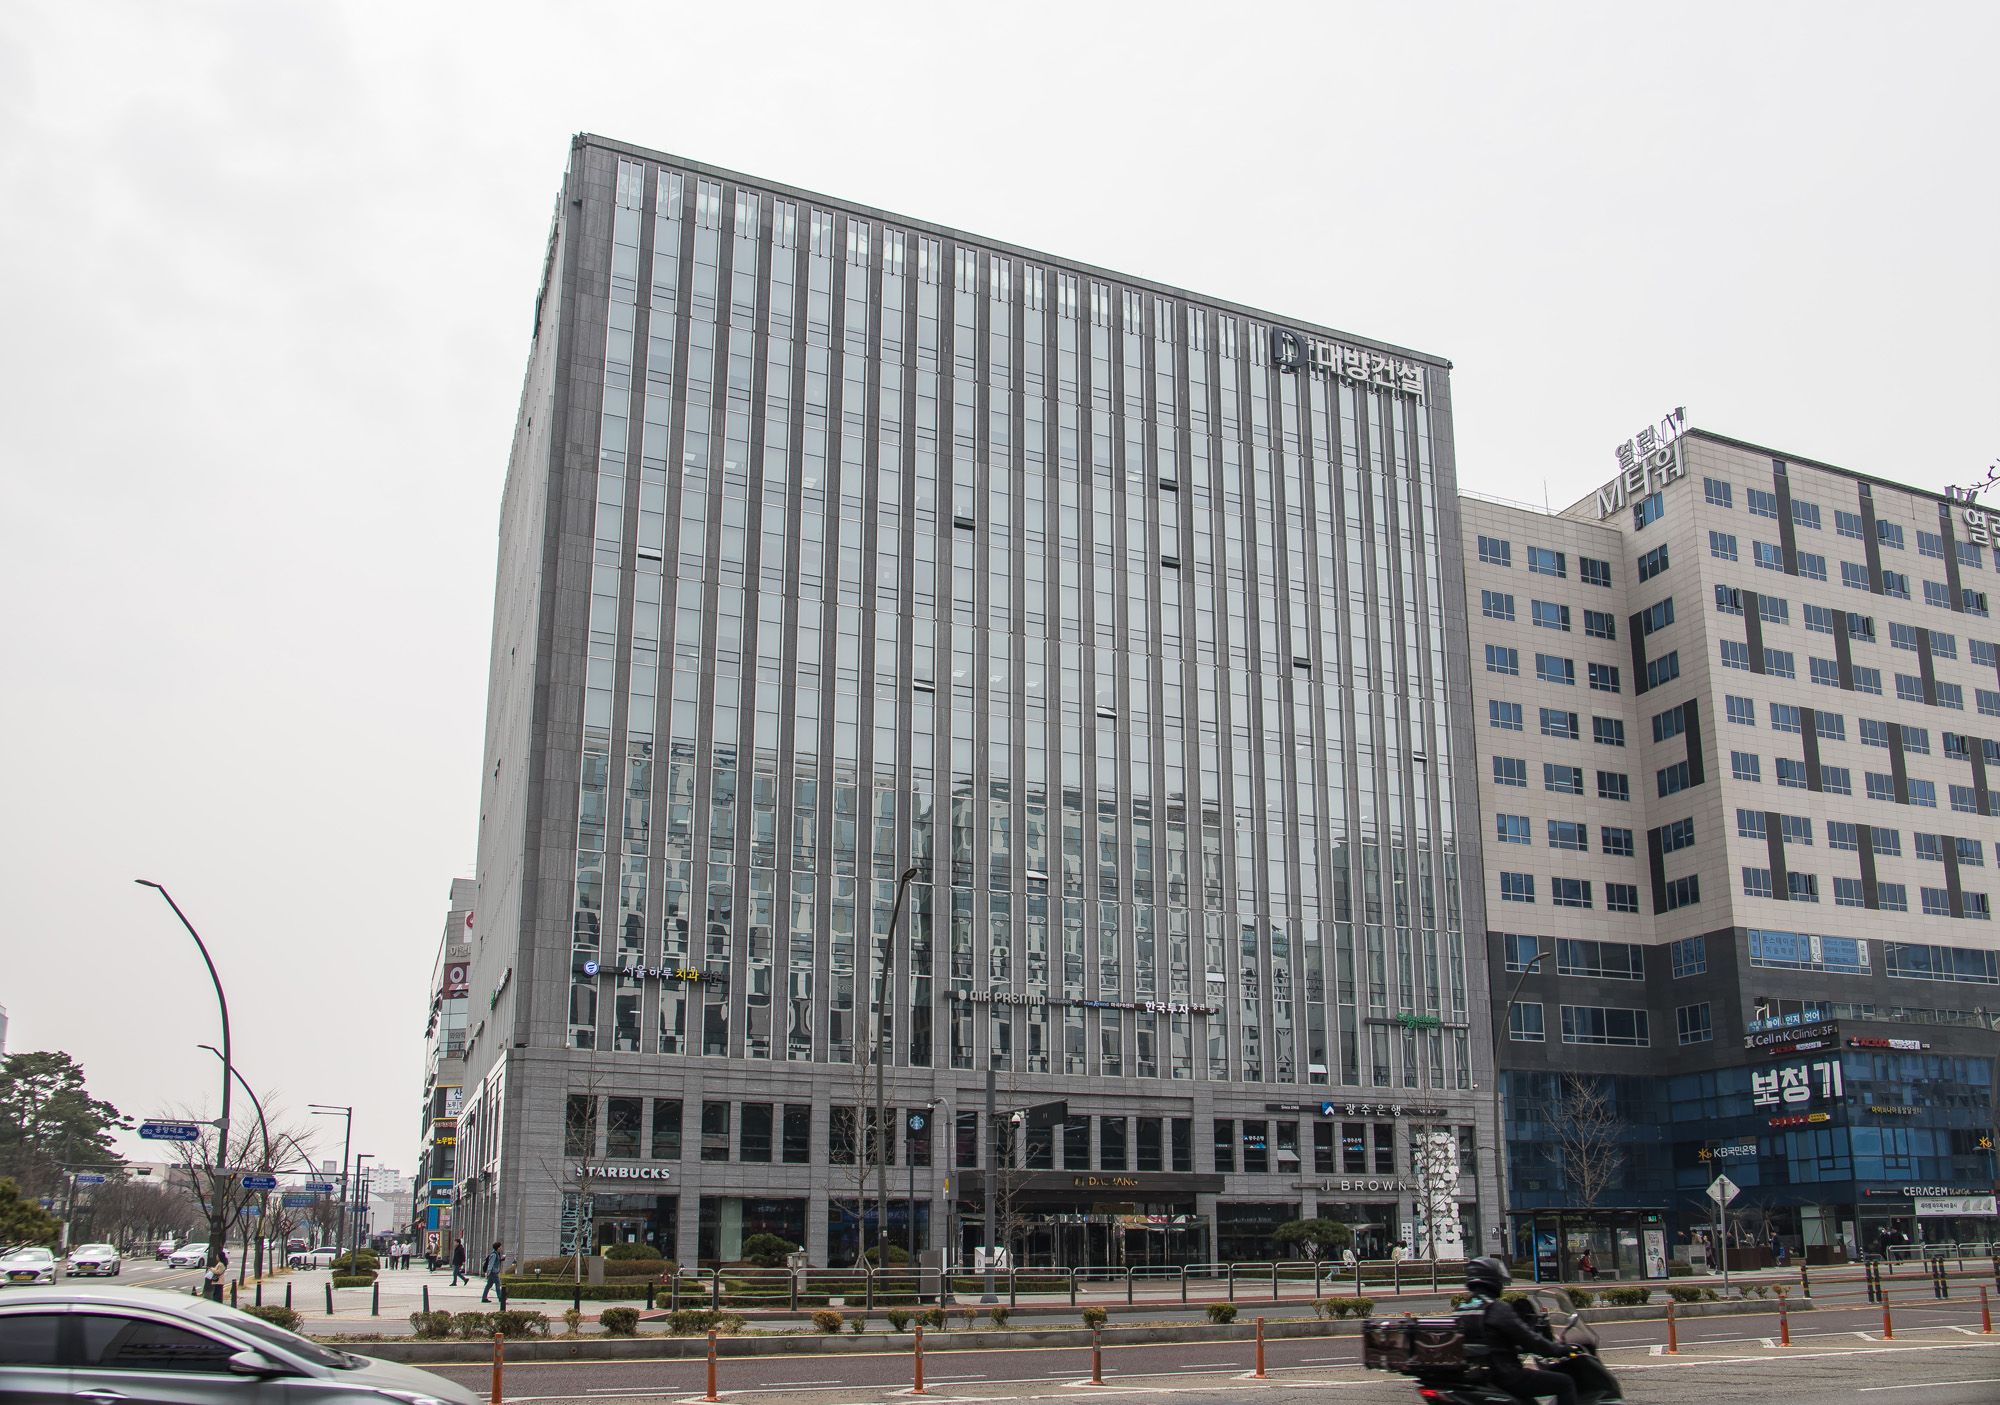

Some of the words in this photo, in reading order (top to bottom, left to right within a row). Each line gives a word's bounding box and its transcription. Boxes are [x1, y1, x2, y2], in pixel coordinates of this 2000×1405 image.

[1317, 341, 1424, 396] 대방건설
[1615, 424, 1656, 471] 열린
[1396, 1012, 1440, 1024] Schneider
[1785, 1015, 1800, 1025] 인지
[1804, 1011, 1820, 1022] 언어
[1791, 1028, 1818, 1040] Clinic
[1751, 1060, 1843, 1106] 보청기
[1345, 1103, 1401, 1117] 광주은행
[155, 1126, 184, 1134] 공항대로
[1713, 1145, 1757, 1158] KB국민은행
[576, 1166, 670, 1179] STARBUCKS
[1341, 1180, 1407, 1191] BROWN
[1903, 1186, 1948, 1197] CERAGEM
